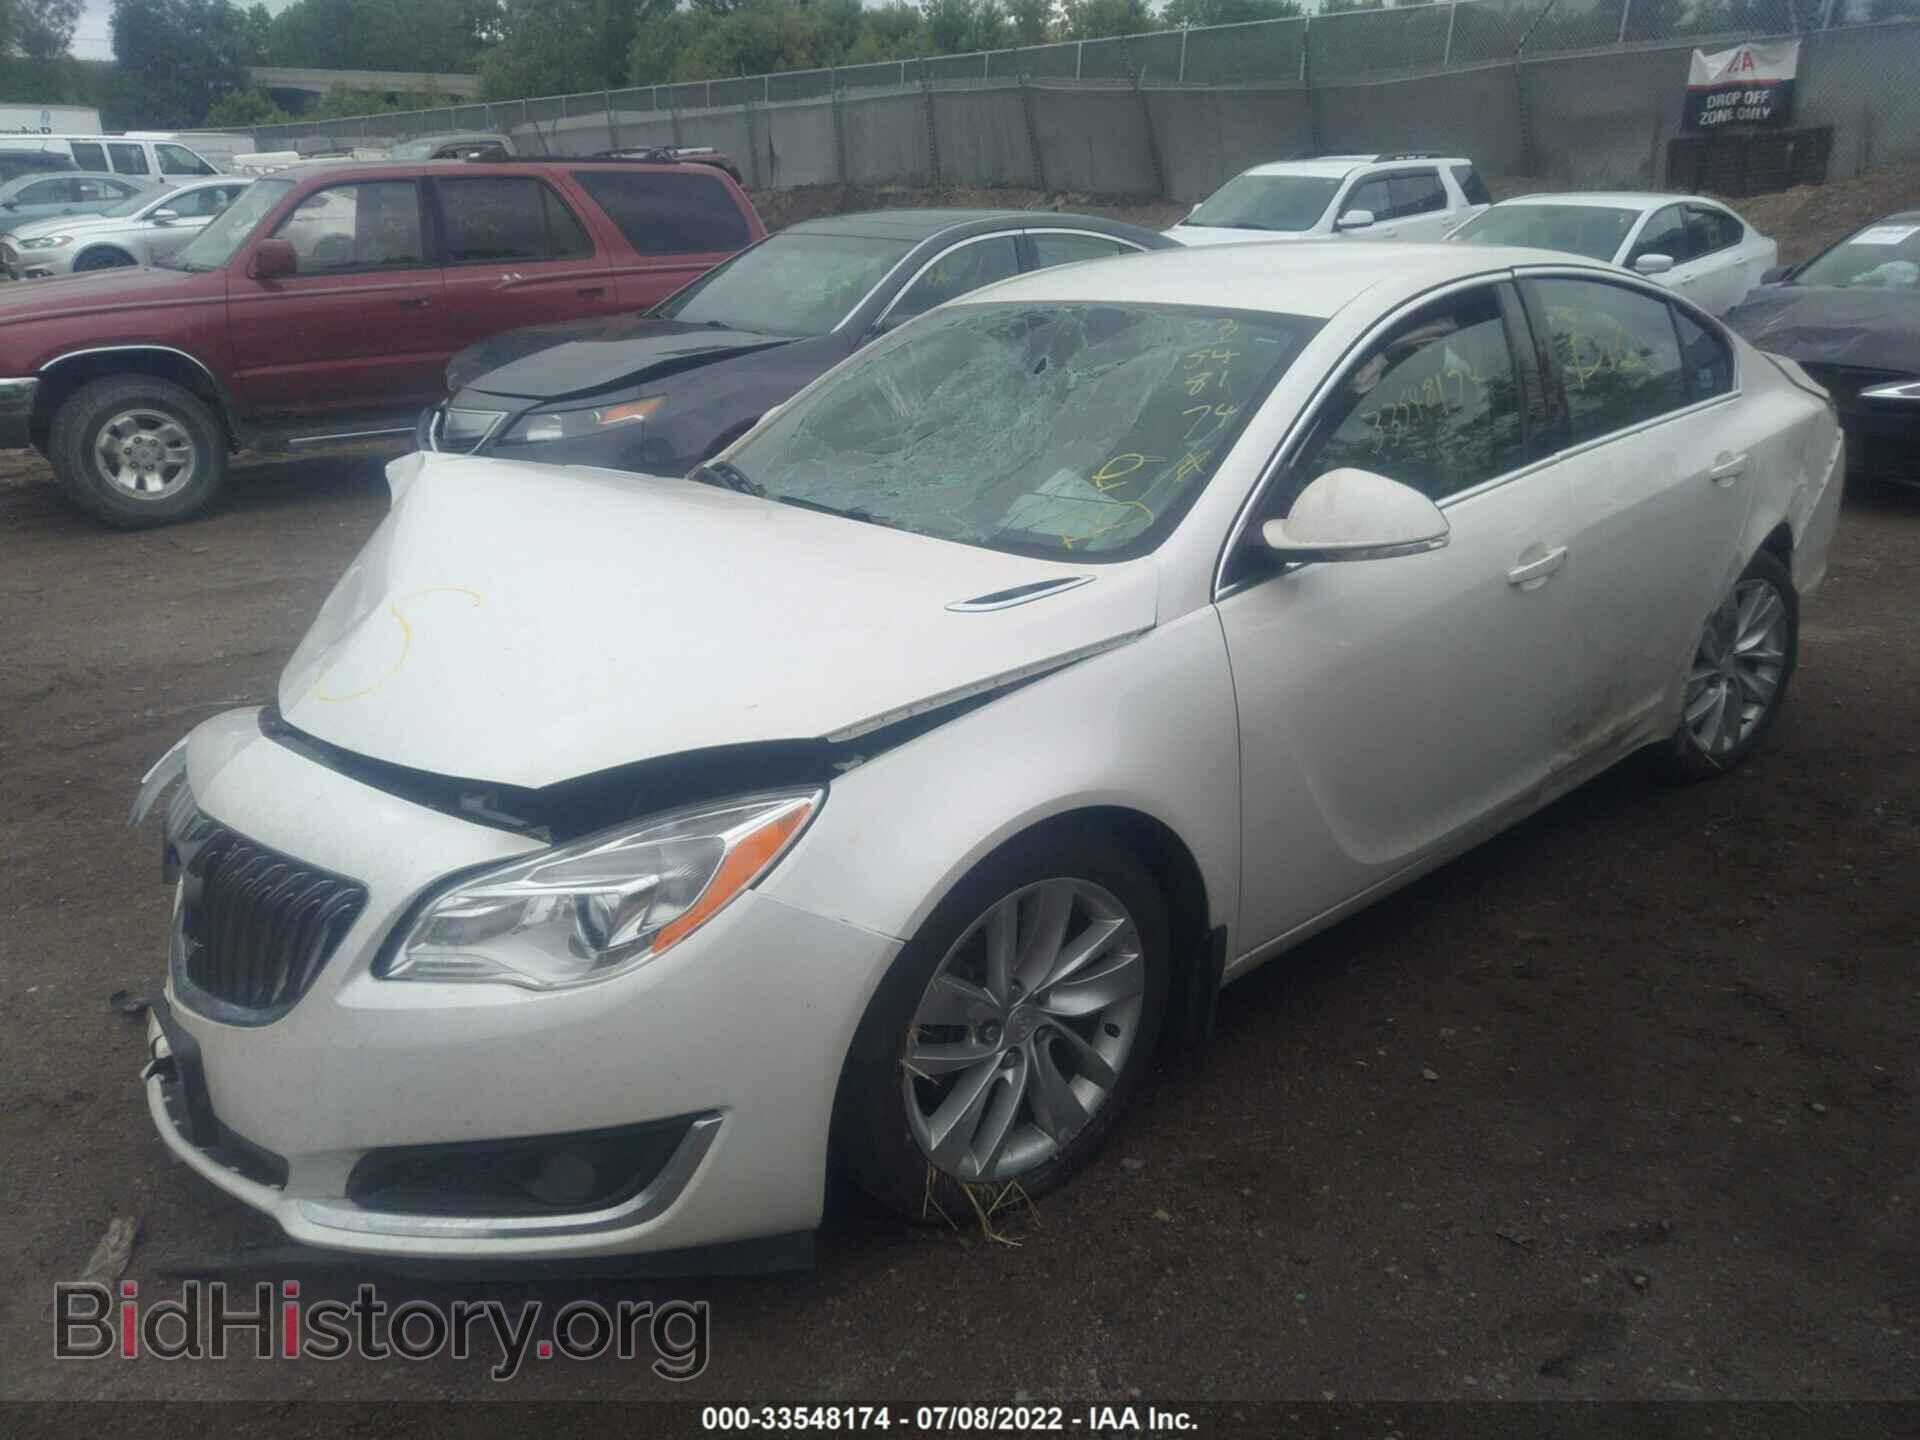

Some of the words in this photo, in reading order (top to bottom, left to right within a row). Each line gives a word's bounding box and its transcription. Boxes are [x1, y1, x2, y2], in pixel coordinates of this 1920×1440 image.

[1706, 91, 1742, 109] DROP
[1743, 90, 1770, 105] OFF
[1699, 108, 1734, 126] ZONE
[1736, 106, 1771, 121] ONLY
